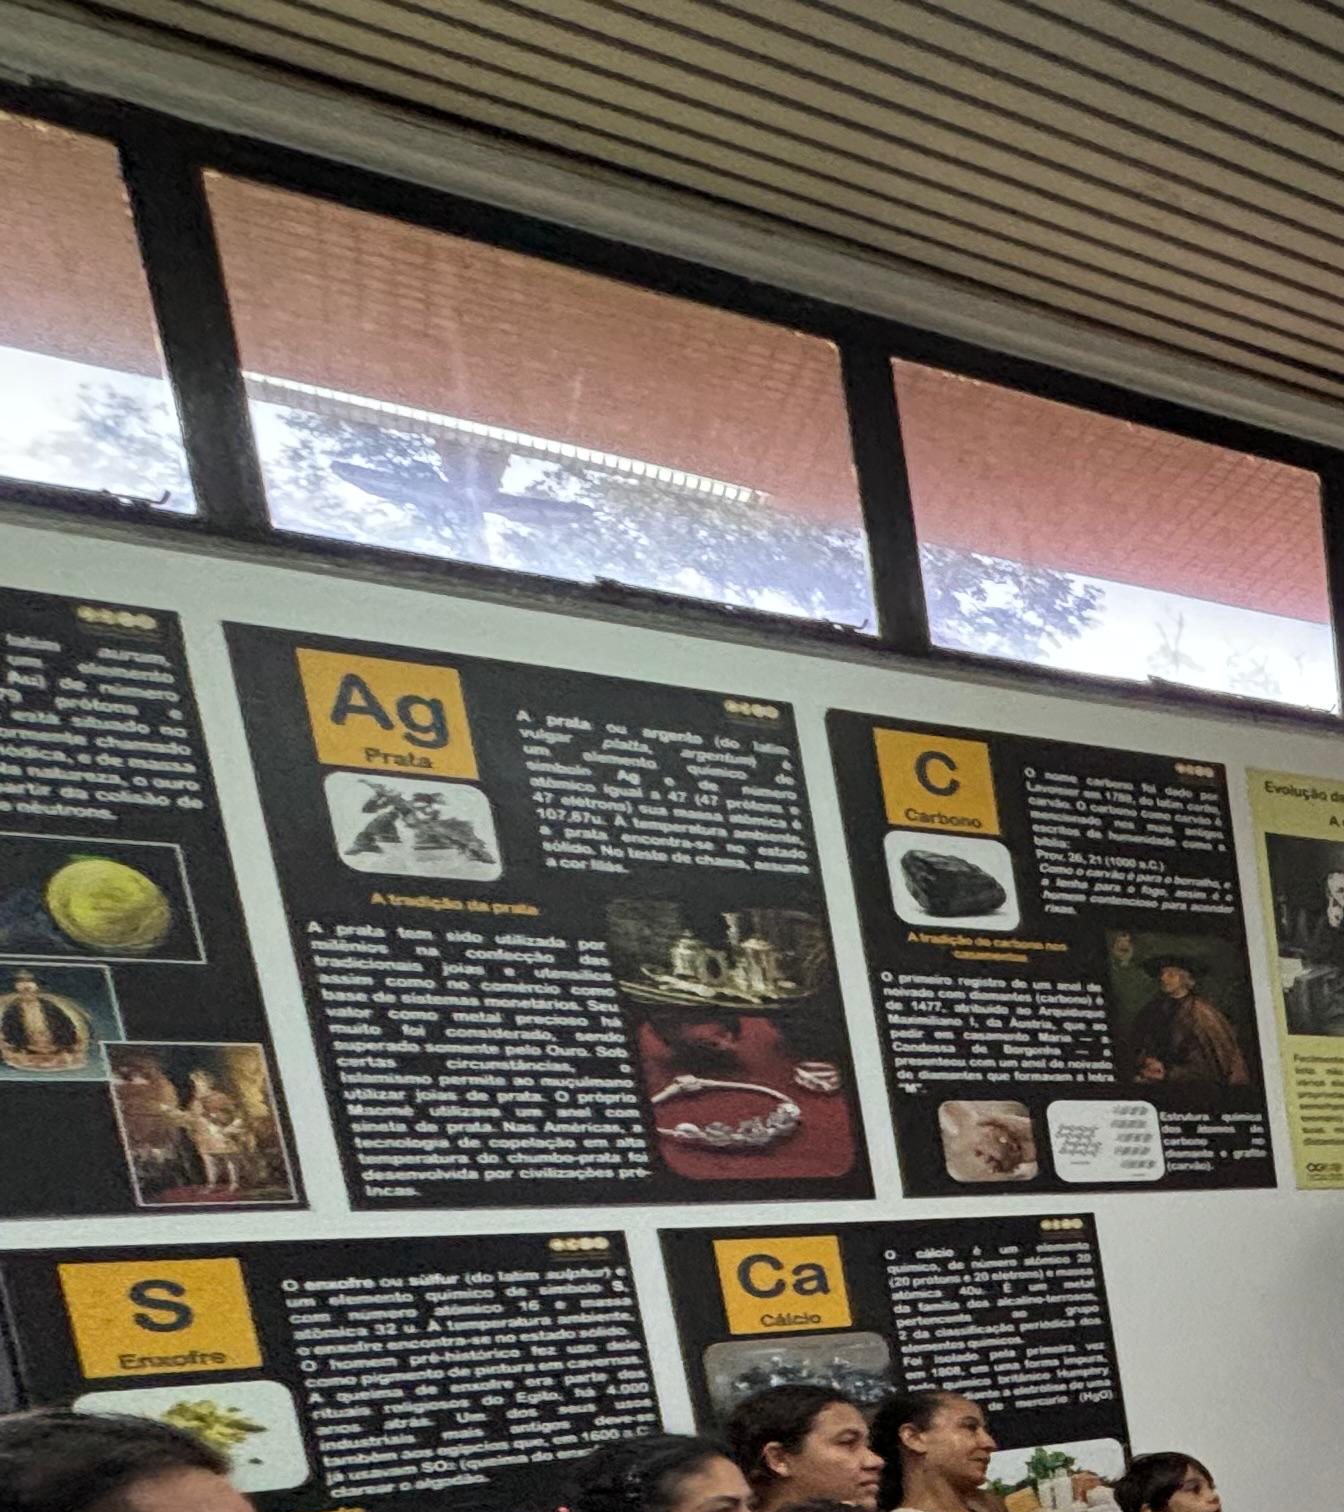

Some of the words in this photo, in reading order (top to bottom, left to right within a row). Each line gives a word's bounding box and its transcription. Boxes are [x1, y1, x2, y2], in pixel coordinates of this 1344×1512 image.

[330, 672, 450, 748] Ag
[364, 746, 434, 770] Prata
[916, 750, 960, 796] C
[1264, 780, 1327, 802] Evolução
[904, 807, 982, 830] Carbono
[1329, 815, 1340, 827] A
[307, 920, 323, 933] A
[736, 1253, 831, 1299] Ca
[130, 1280, 195, 1333] S
[759, 1311, 822, 1328] Cálcio
[118, 1348, 226, 1370] Enxofre
